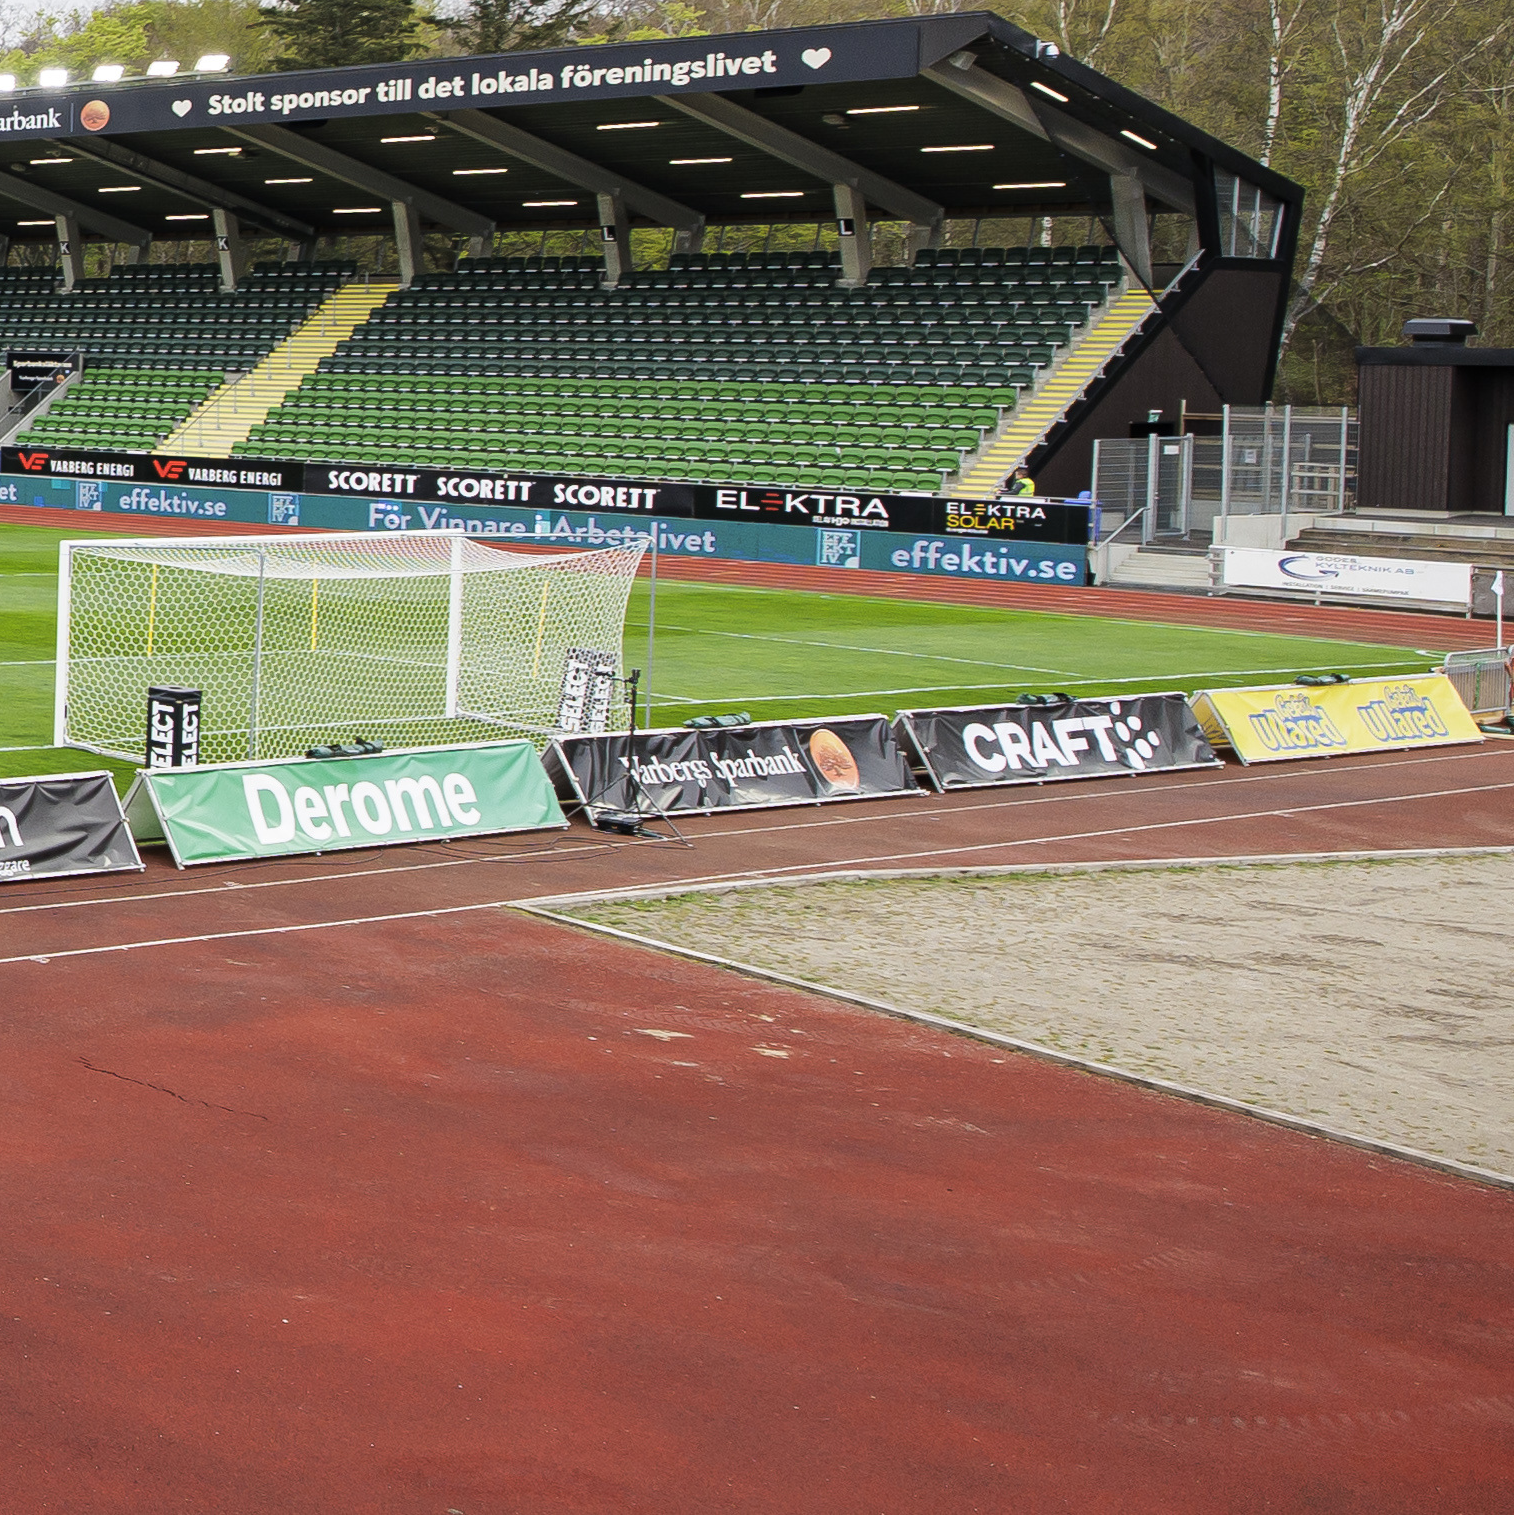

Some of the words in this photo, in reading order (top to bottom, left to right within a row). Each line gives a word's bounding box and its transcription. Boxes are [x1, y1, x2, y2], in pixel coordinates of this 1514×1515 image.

[208, 92, 265, 116] Stolt
[270, 86, 372, 114] sponsor
[376, 78, 413, 102] till
[418, 76, 465, 100] det
[471, 68, 554, 95] lokala
[561, 50, 777, 89] föreningslivet
[603, 226, 614, 241] L
[840, 219, 852, 235] L
[60, 241, 70, 254] K
[216, 237, 228, 250] K
[50, 460, 95, 475] VARBERG
[96, 463, 135, 477] ENERGI
[188, 467, 237, 484] VARBERG
[240, 470, 282, 486] ENERGI
[328, 470, 418, 494] SCORETT
[437, 476, 534, 501] SCORETT
[120, 487, 227, 516] effektiv.se
[554, 483, 657, 509] SCORETT
[370, 502, 411, 530] För
[417, 505, 527, 533] Vinnare
[548, 516, 716, 553] Arbetslivet
[946, 515, 1015, 531] SOLAR
[890, 540, 1077, 581] effektiv.se
[1315, 562, 1392, 573] KYLTEKNIK
[150, 700, 174, 768] ELECT
[181, 703, 199, 767] ELECT
[962, 715, 1117, 773] CRAFT
[618, 755, 712, 789] Varbergs
[709, 745, 807, 788] Sparbank
[242, 771, 481, 846] Derome
